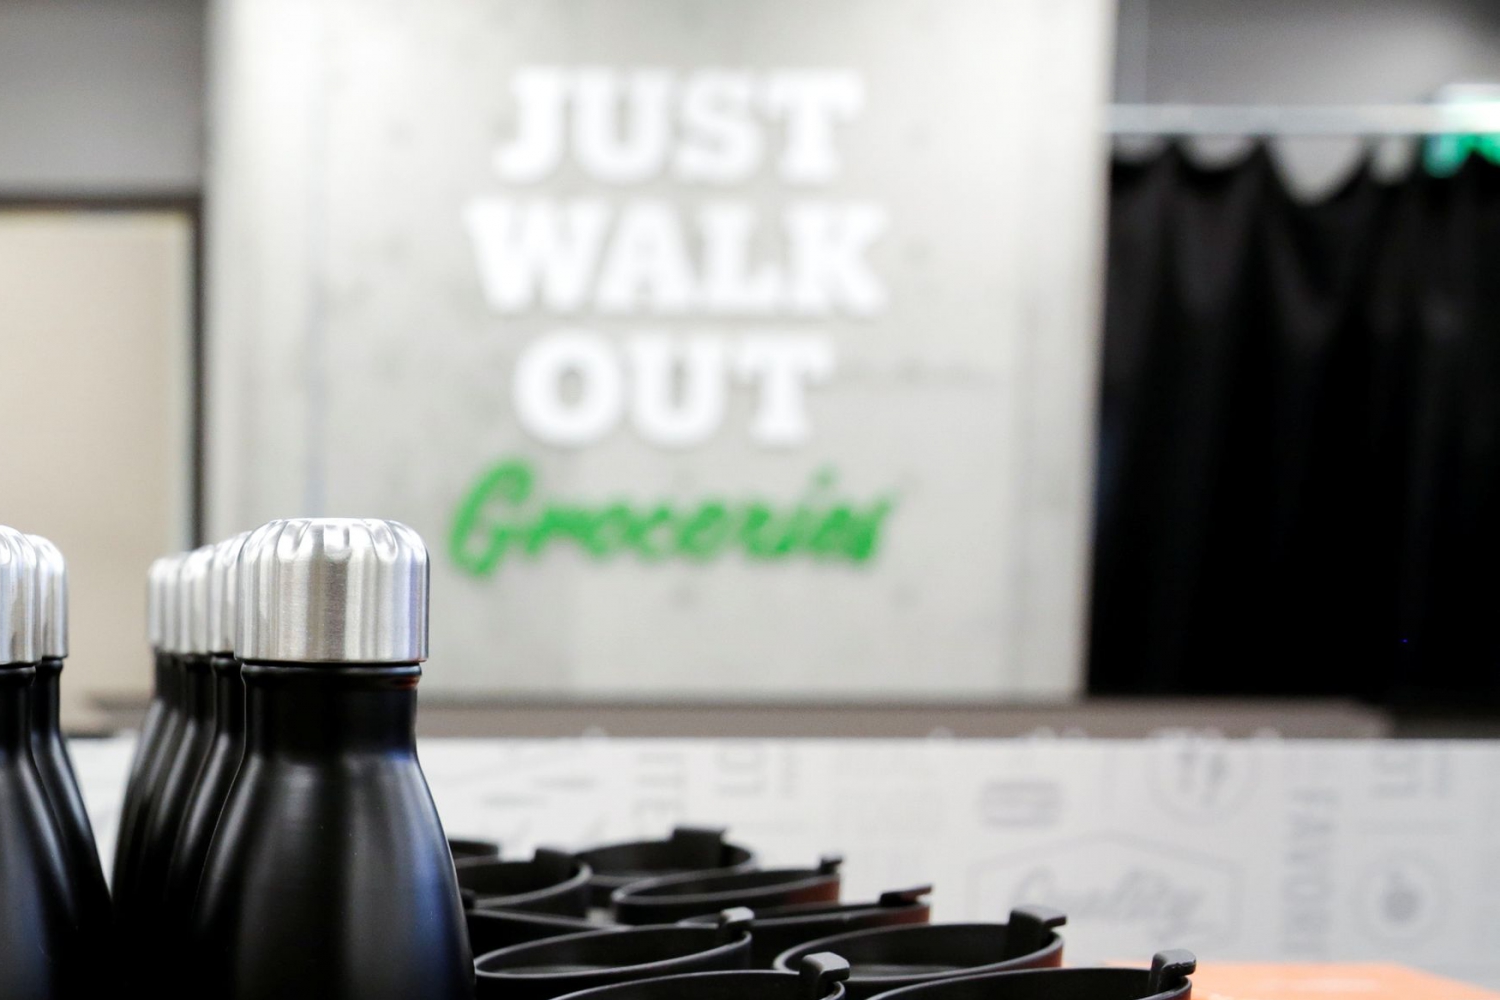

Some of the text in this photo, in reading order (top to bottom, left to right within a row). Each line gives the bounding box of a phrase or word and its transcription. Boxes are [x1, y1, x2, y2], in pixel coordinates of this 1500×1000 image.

[496, 66, 863, 183] JUST
[465, 200, 887, 316] WALK
[512, 329, 834, 447] OUT
[449, 459, 895, 581] Groceries
